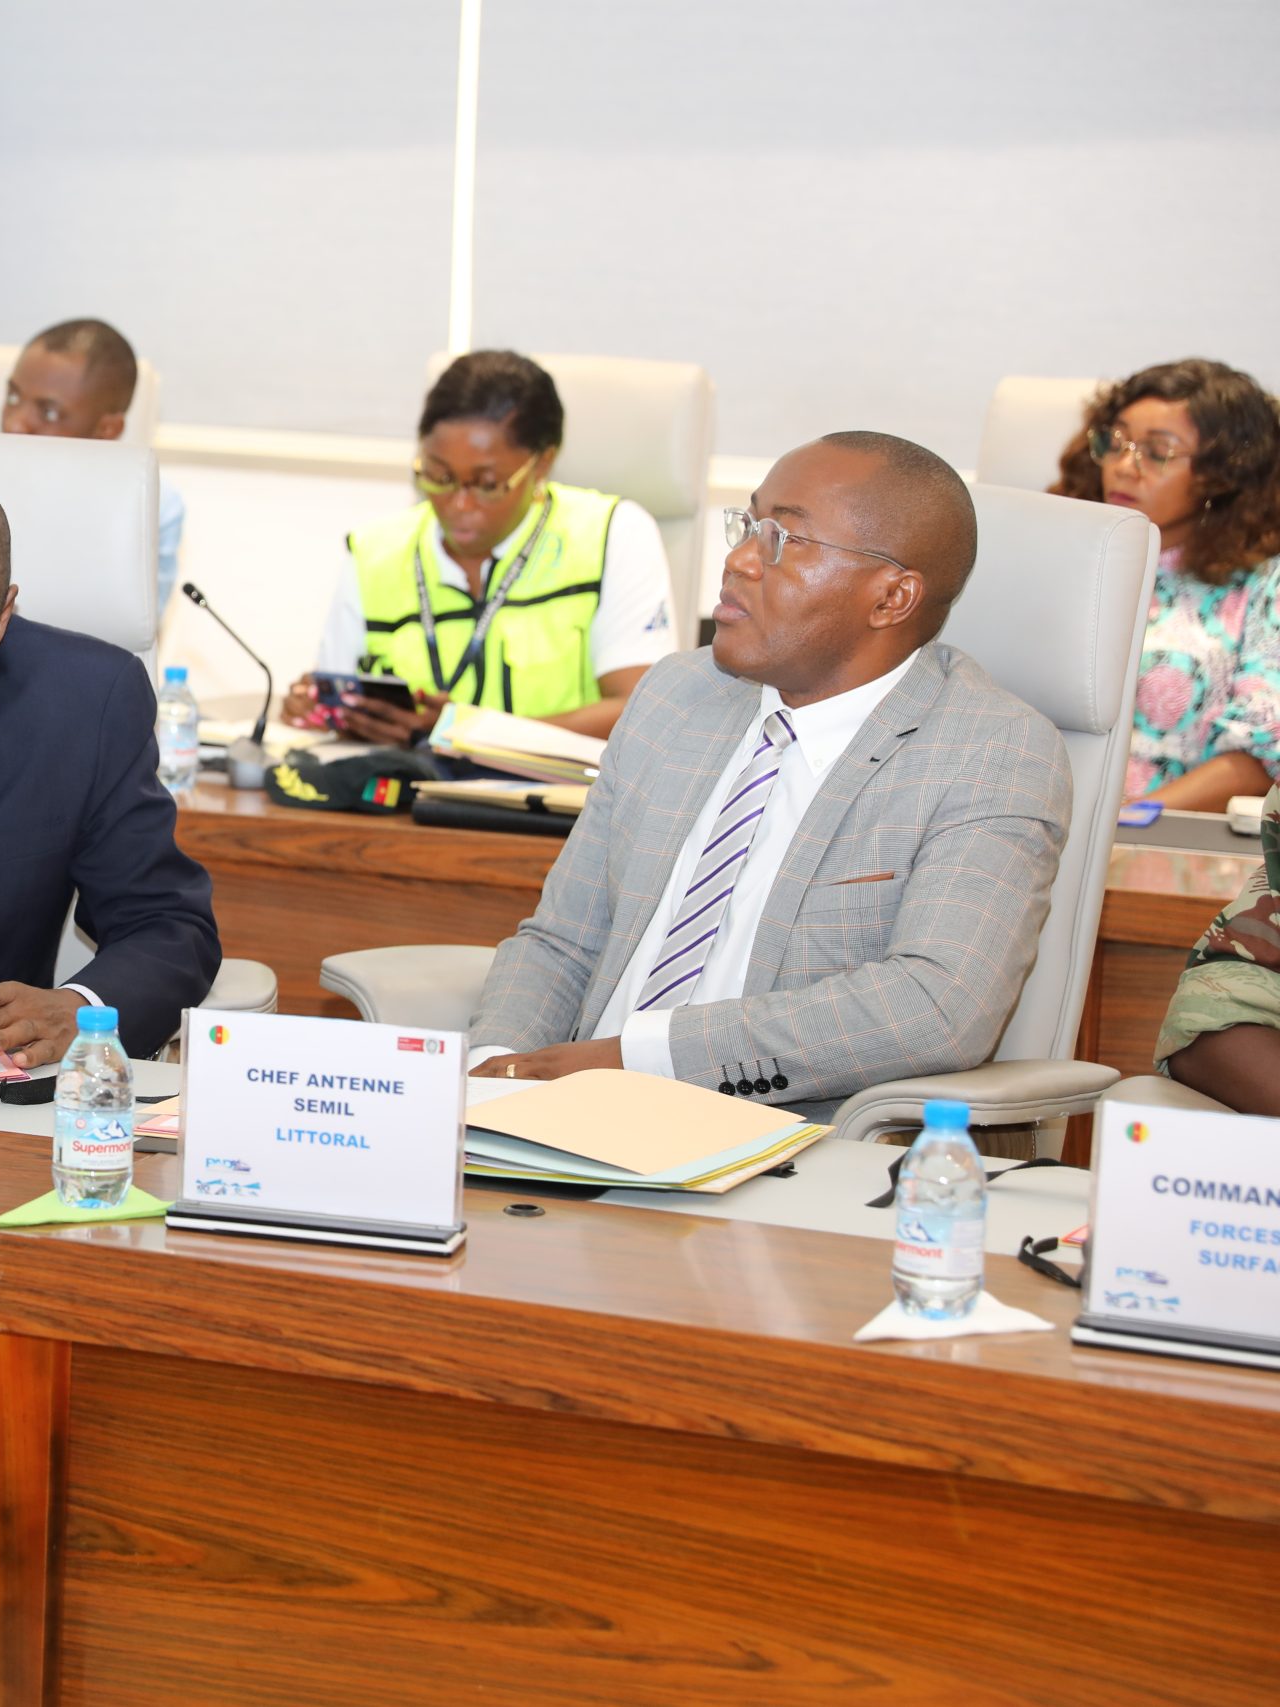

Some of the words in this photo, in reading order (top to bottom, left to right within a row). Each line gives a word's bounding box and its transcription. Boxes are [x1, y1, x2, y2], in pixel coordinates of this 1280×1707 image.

[246, 1068, 300, 1086] CHEF
[306, 1073, 405, 1096] ANTENNE
[293, 1097, 355, 1117] SEMIL
[276, 1127, 371, 1150] LITTORAL
[1199, 1249, 1280, 1274] SURFA
